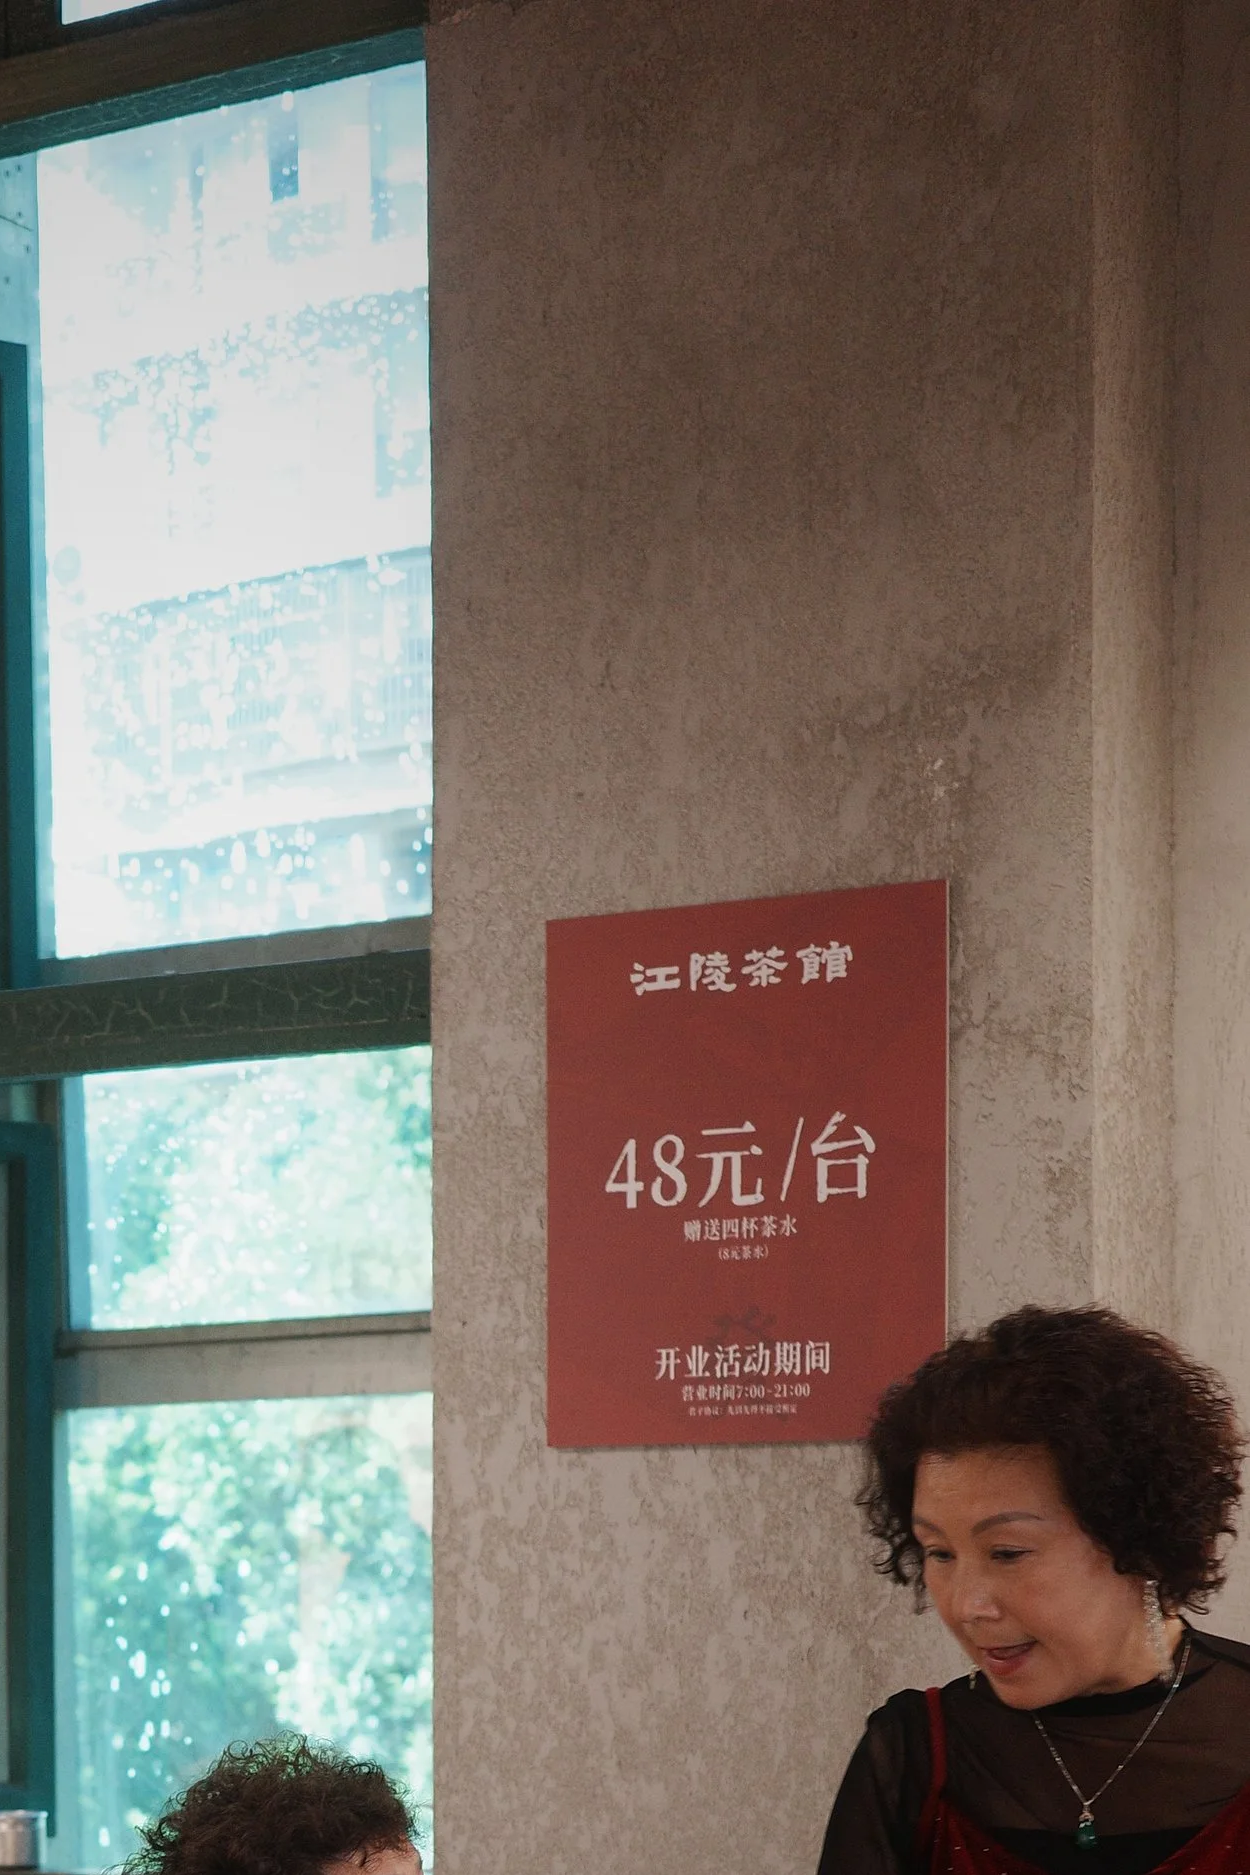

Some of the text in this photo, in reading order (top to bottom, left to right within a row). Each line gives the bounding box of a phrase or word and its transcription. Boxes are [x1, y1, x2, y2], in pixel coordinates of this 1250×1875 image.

[630, 940, 854, 996] 江陵茶館
[684, 1214, 797, 1242] 赠送四杯茶水
[654, 1340, 831, 1381] 开业活动期间
